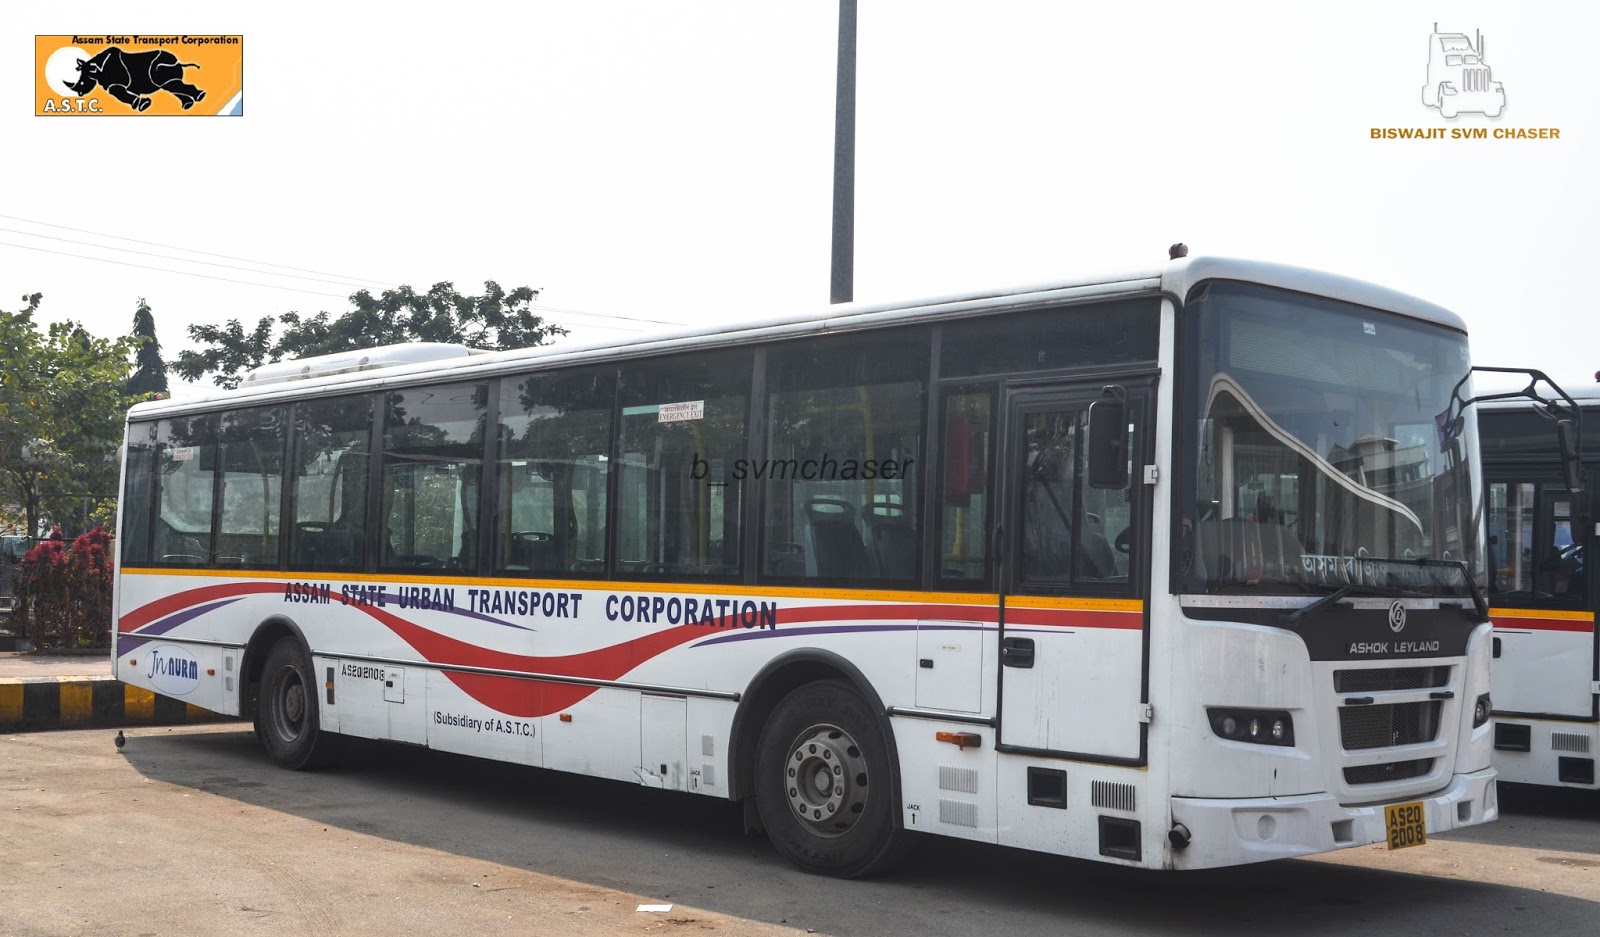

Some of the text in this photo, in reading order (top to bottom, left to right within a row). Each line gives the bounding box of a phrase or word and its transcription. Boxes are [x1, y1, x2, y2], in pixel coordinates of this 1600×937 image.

[691, 410, 702, 419] EXIT
[284, 582, 777, 630] ASSAM STATE URBAN TRANSPORT CORPORATION
[1349, 641, 1440, 654] ASHOK LEYLAND
[433, 710, 536, 739] (Subsidiary of A.S.T.C.)
[906, 803, 921, 811] JACK
[1390, 805, 1421, 828] AS20
[1391, 823, 1424, 849] 2008
